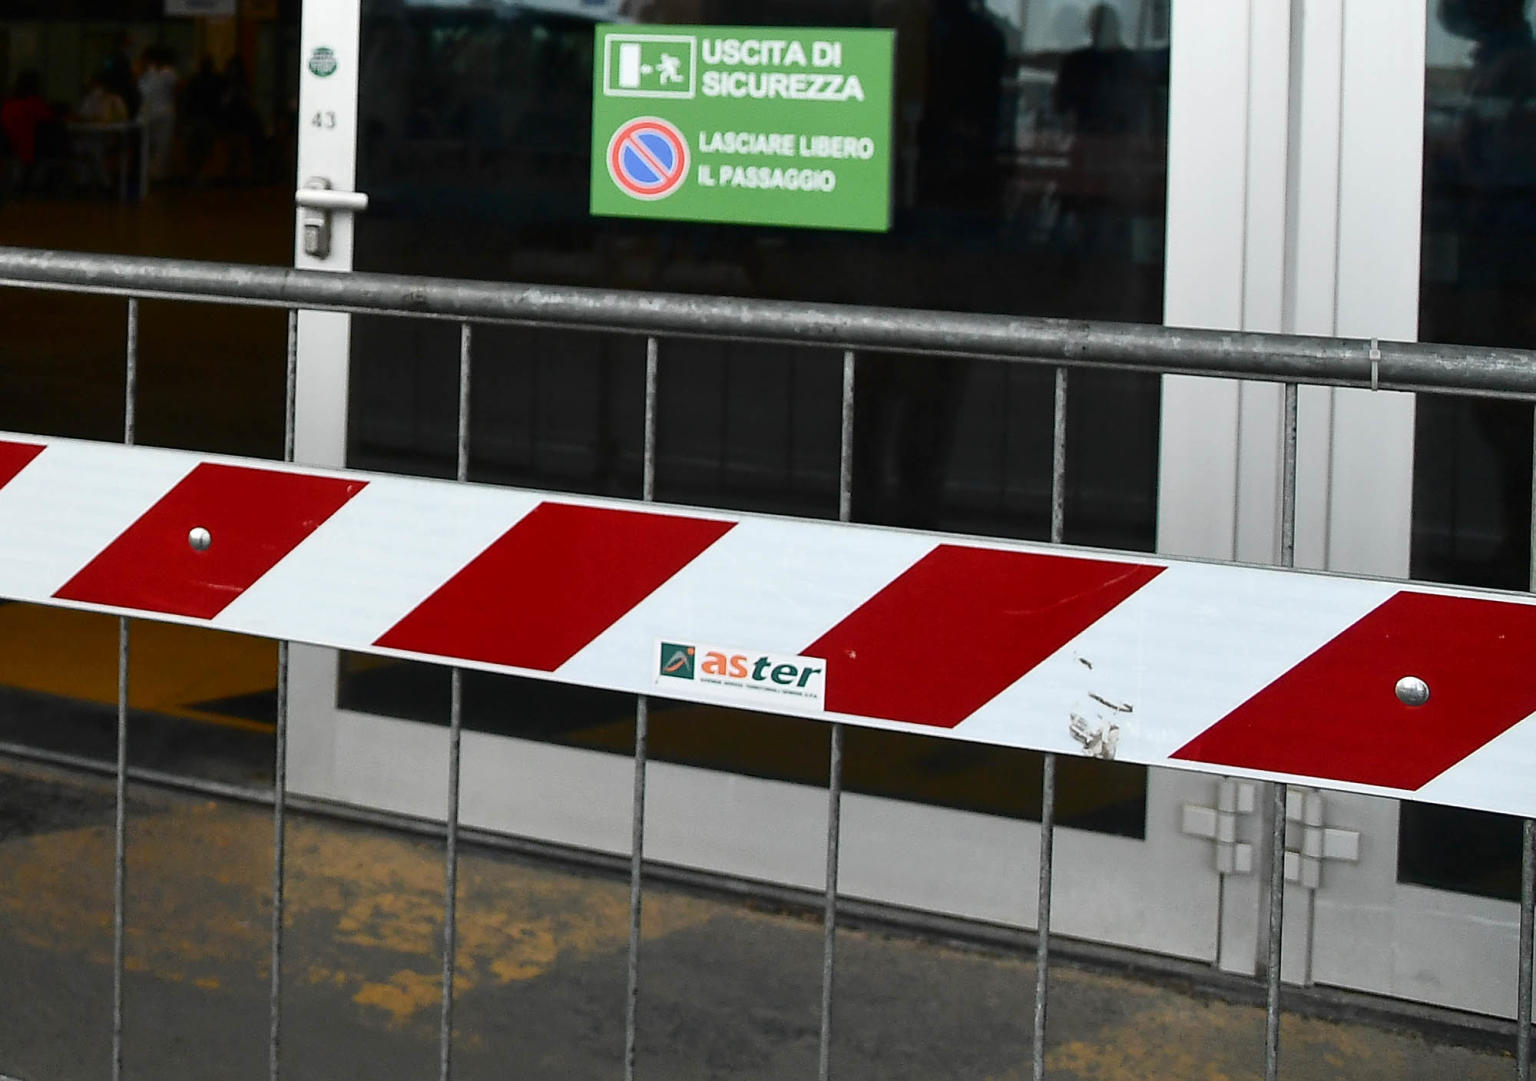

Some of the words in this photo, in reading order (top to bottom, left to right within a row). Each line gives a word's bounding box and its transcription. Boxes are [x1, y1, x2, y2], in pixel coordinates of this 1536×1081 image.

[702, 38, 807, 67] USCITA
[812, 40, 842, 68] DI
[702, 71, 864, 101] SICUREZZA
[312, 110, 337, 129] 43
[699, 131, 795, 156] LASCIARE
[799, 135, 875, 160] LIBERO
[698, 165, 714, 186] IL
[719, 166, 836, 191] PASSAGGIO
[702, 651, 821, 688] aster
